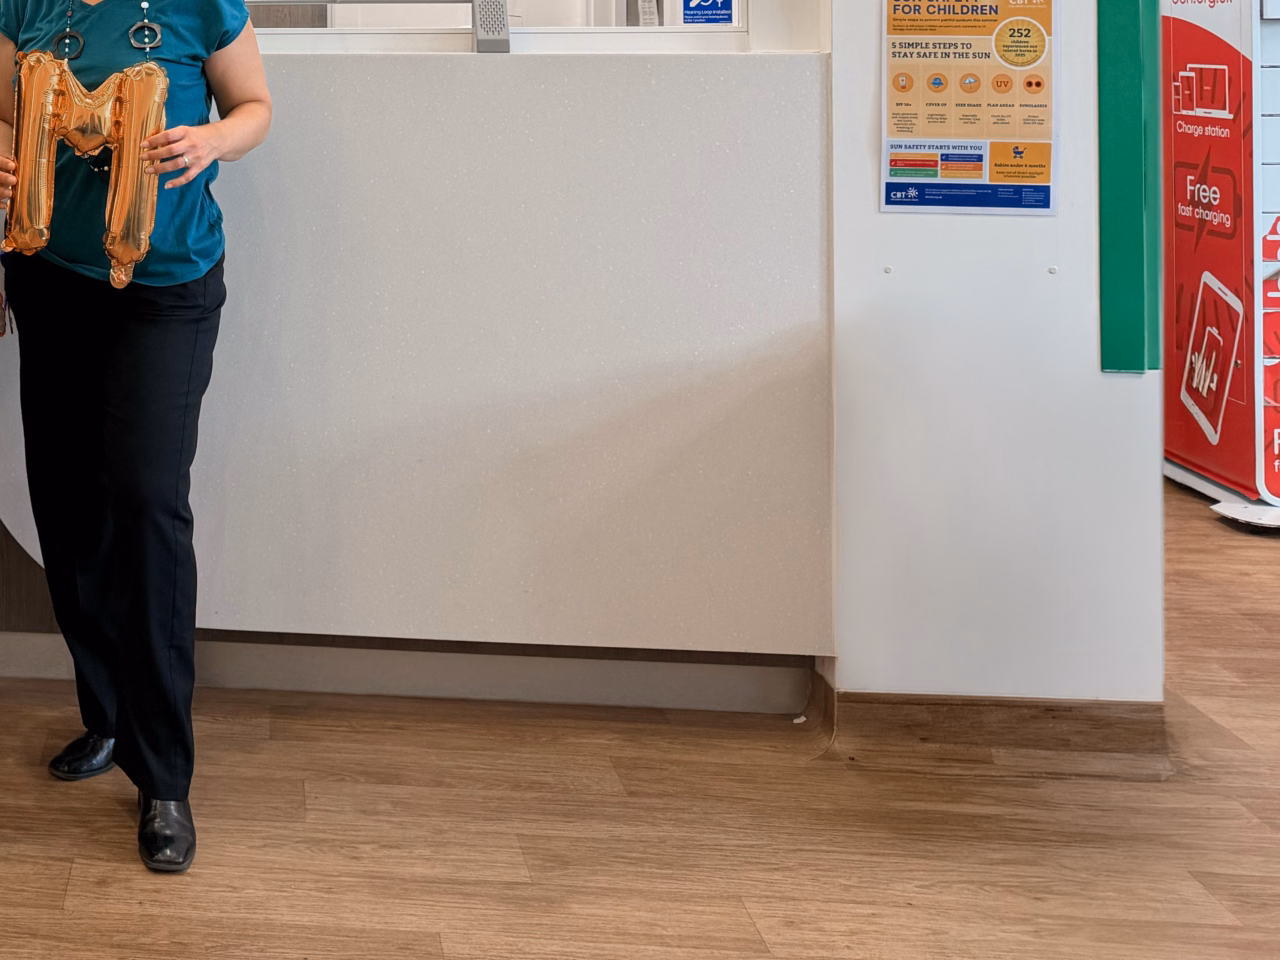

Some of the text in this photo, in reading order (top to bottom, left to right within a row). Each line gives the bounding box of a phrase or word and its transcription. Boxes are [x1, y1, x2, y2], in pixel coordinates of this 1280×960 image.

[893, 4, 921, 15] FOR
[926, 4, 998, 15] CHILDREN
[1009, 28, 1031, 38] 252
[1176, 120, 1230, 138] Charge station
[1187, 176, 1220, 205] Free
[1178, 203, 1230, 227] fast charging
